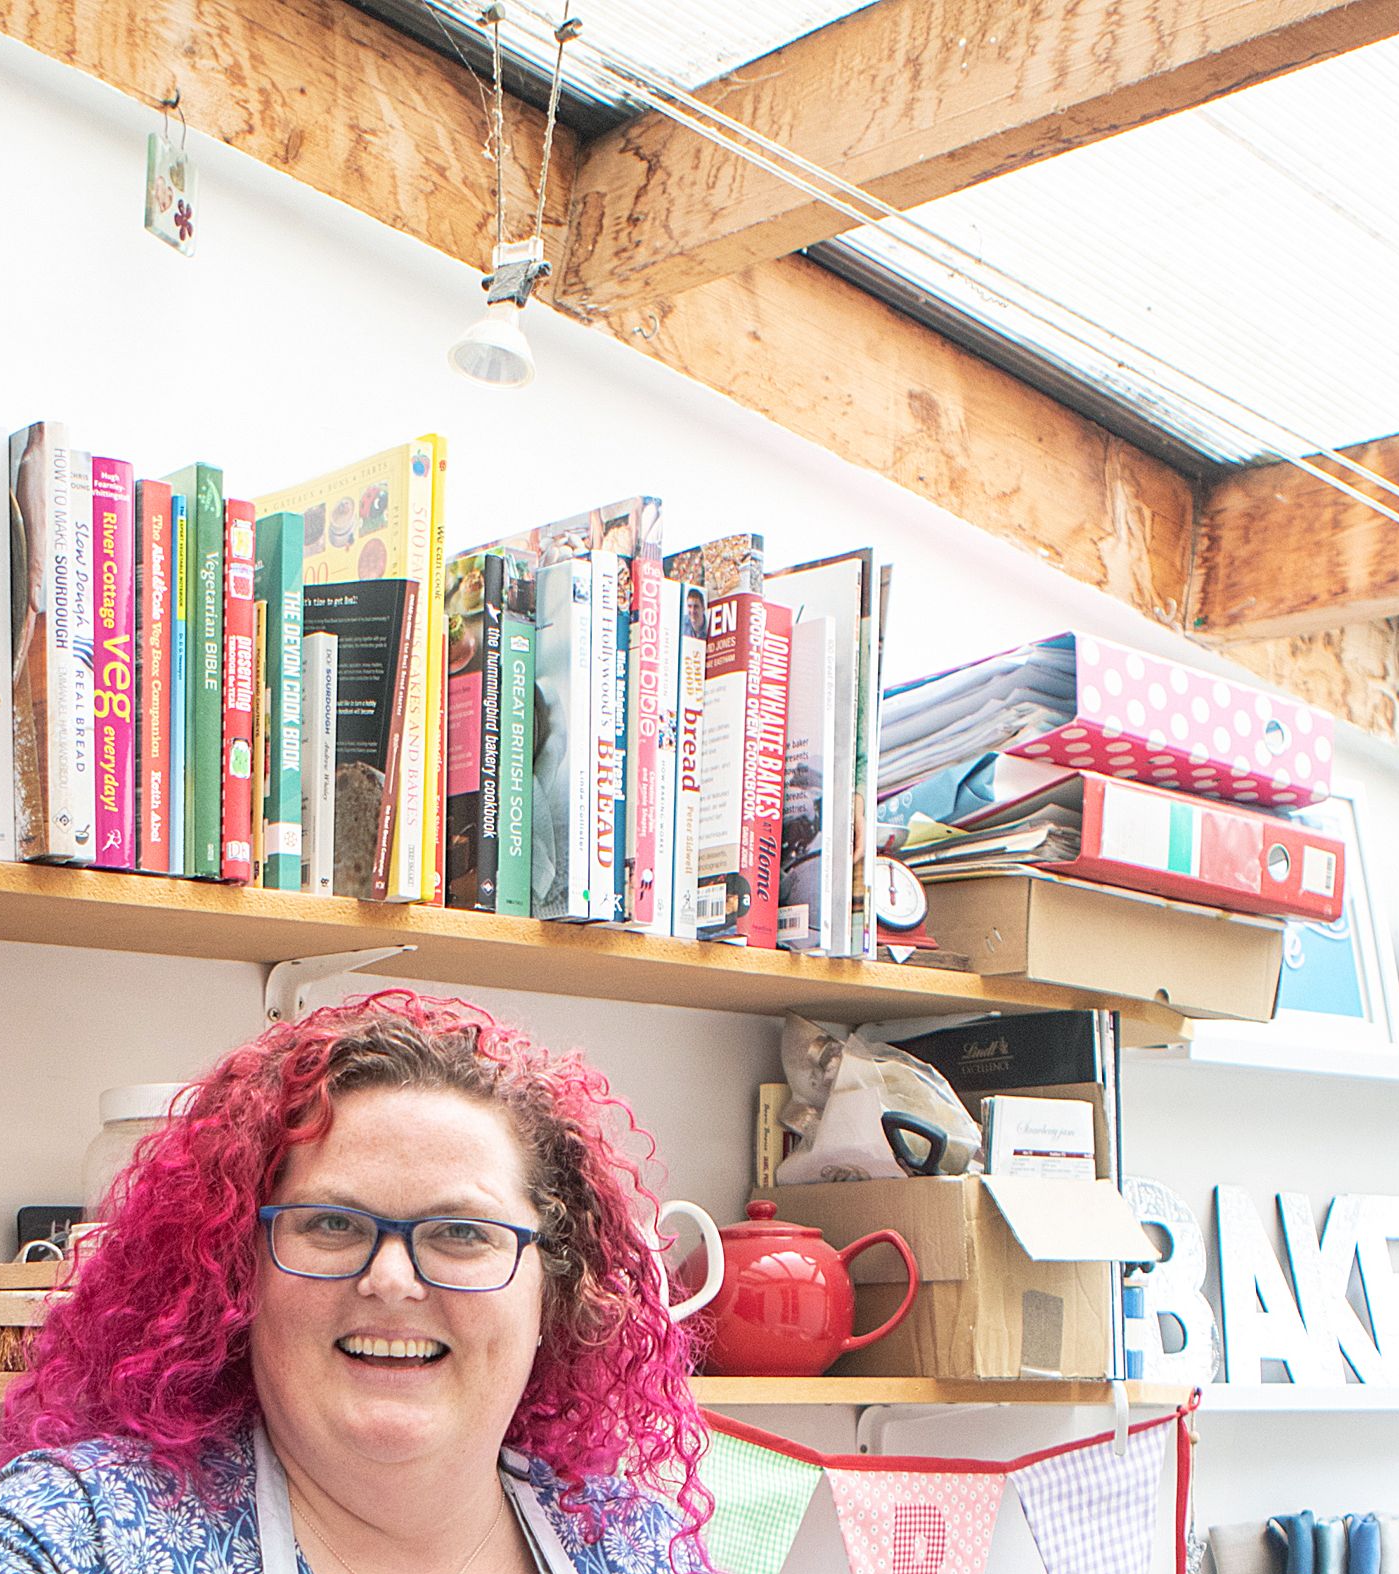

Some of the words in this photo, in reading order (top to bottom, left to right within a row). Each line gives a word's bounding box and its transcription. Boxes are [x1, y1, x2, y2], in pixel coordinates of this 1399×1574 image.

[53, 448, 67, 479] HOW
[54, 483, 67, 507] TO
[54, 510, 68, 551] MAKE
[74, 521, 90, 566] Slow
[102, 512, 117, 559] River
[152, 514, 164, 542] The
[54, 555, 69, 650] SOURDOUGH
[72, 568, 90, 628] Dough
[99, 561, 118, 631] Cottage
[201, 551, 219, 638] Vegetarian
[283, 591, 300, 620] THE
[601, 572, 614, 614] Paul
[150, 621, 163, 648] Veg
[487, 627, 500, 648] the
[640, 579, 661, 663] bread
[747, 602, 766, 694] WOOD-FIRED
[151, 648, 162, 678] Box
[205, 642, 218, 691] BIBLE
[236, 635, 253, 713] preserving
[283, 623, 300, 677] DEVON
[598, 618, 614, 727] Hollywood's
[684, 657, 694, 696] GOOD
[692, 651, 704, 704] SIMPLY
[763, 630, 789, 682] JOHN
[75, 670, 85, 711] REAL
[94, 633, 131, 723] Veg
[283, 679, 300, 724] COOK
[483, 651, 500, 731] hummingbird
[511, 660, 526, 720] GREAT
[639, 669, 659, 738] bible
[75, 717, 86, 773] BREAD
[149, 679, 163, 759] Companion
[407, 722, 421, 763] AND
[746, 698, 759, 739] OVEN
[759, 683, 787, 756] WHAITE
[101, 725, 120, 813] everyday!
[283, 725, 300, 772] BOOK
[482, 735, 499, 777] bakery
[510, 723, 525, 791] BRITISH
[614, 749, 626, 801] bread
[682, 707, 703, 793] bread
[150, 770, 162, 809] Keith
[406, 767, 420, 826] BAKES
[483, 779, 498, 839] cookbook
[596, 736, 615, 868] BREAD
[743, 741, 757, 822] COOKBOOK
[755, 755, 784, 821] BAKES
[151, 810, 162, 843] Abel
[509, 796, 523, 857] SOUPS
[757, 836, 777, 903] Home
